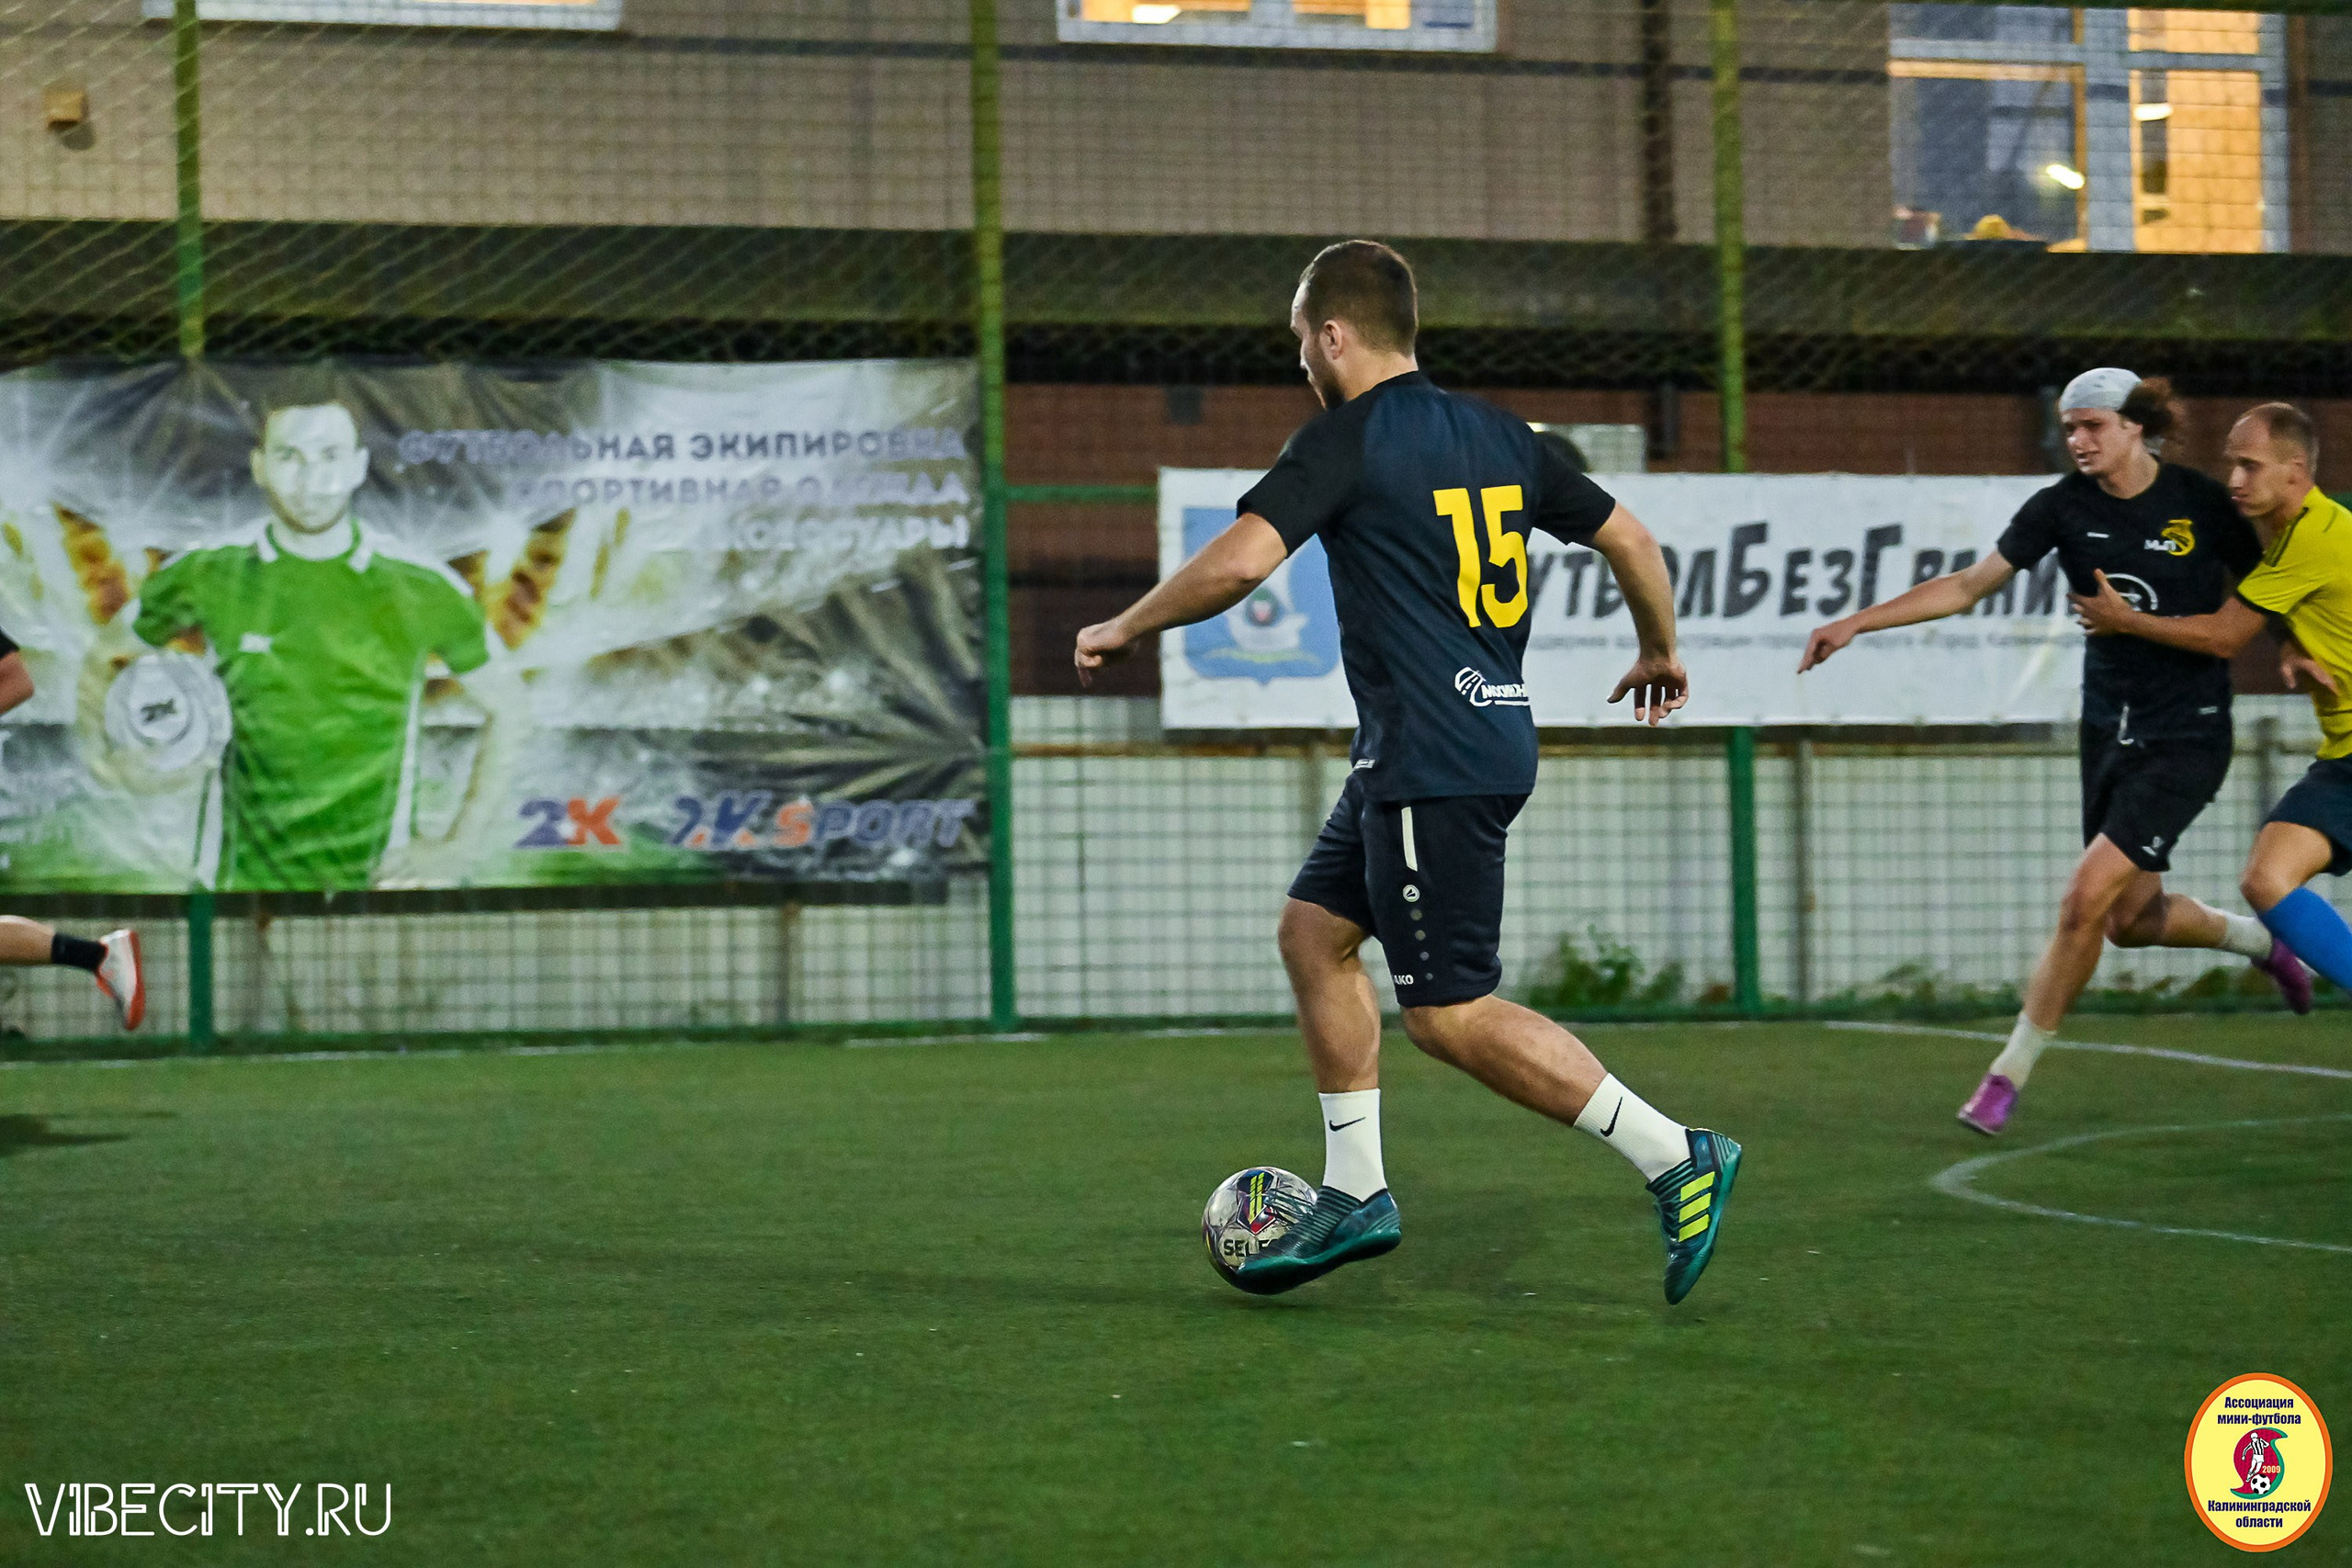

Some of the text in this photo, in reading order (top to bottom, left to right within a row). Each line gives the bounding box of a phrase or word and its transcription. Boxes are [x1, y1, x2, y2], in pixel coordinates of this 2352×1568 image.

[1432, 484, 1529, 628] 15
[514, 796, 622, 846] 2K
[1394, 974, 1415, 985] AKO
